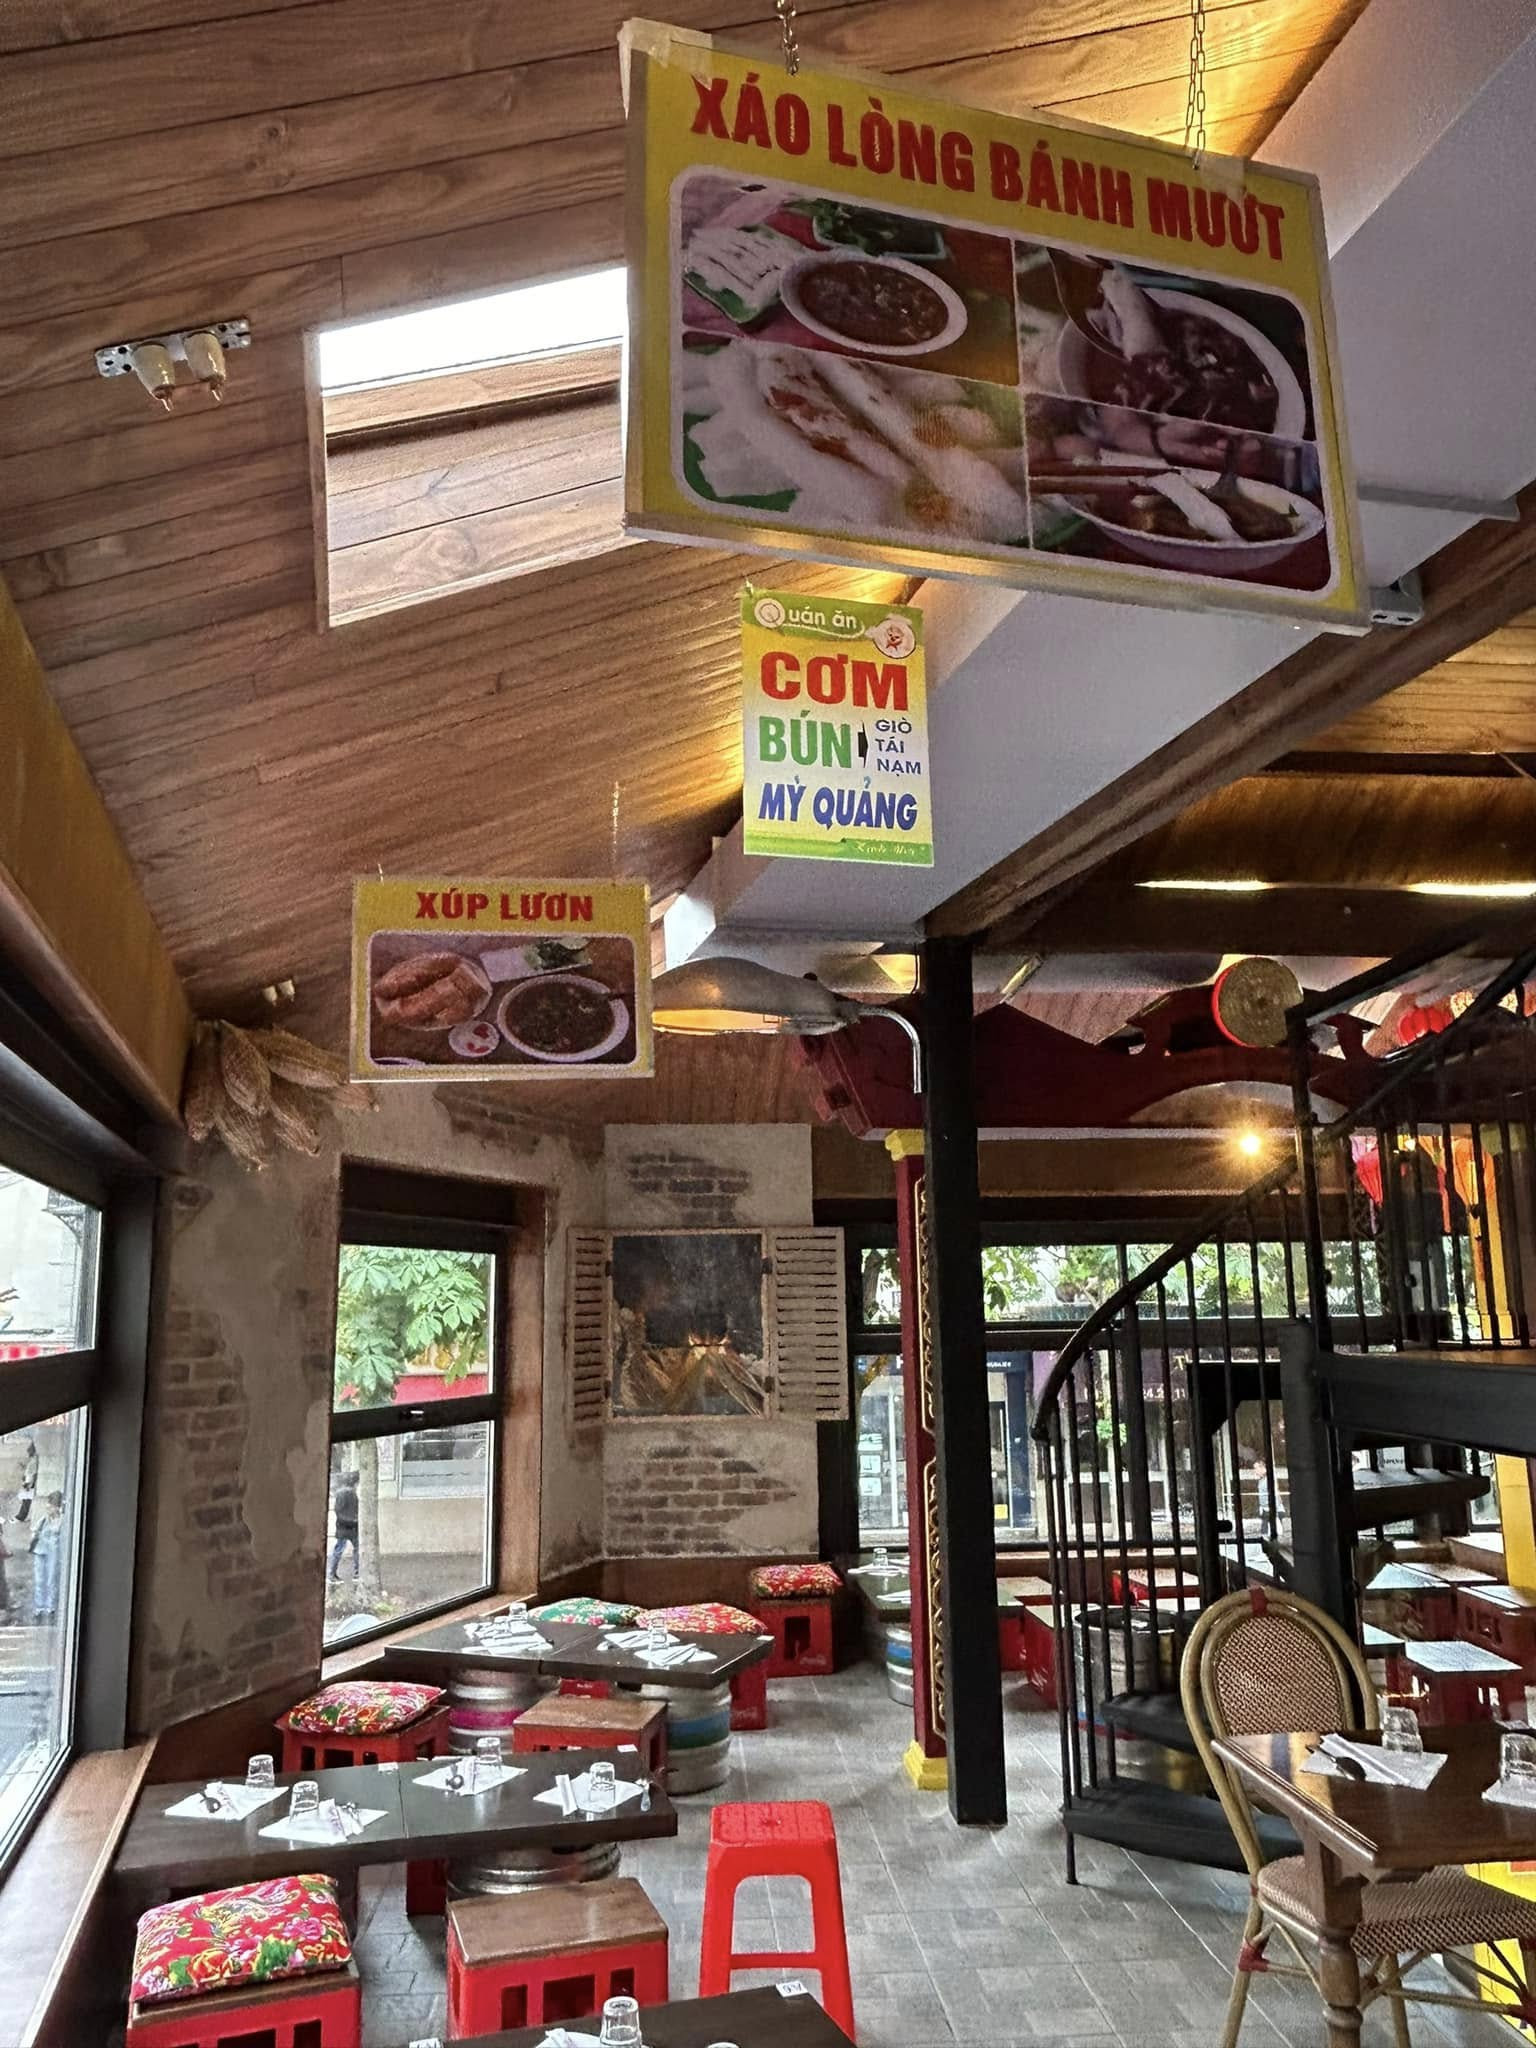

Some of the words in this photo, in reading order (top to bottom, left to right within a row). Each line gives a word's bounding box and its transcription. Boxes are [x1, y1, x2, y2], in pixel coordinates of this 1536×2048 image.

[690, 72, 811, 156] XÁO
[826, 96, 976, 192] LÒNG
[988, 139, 1135, 229] BÁNH
[760, 651, 909, 711] CƠM
[758, 710, 851, 769] BÚN
[875, 717, 912, 734] GIÒ
[875, 736, 905, 754] TÁI
[877, 758, 922, 777] NẠM
[812, 776, 918, 831] QUẢNG
[415, 888, 489, 920] XÚP
[500, 892, 593, 922] LƯƠN
